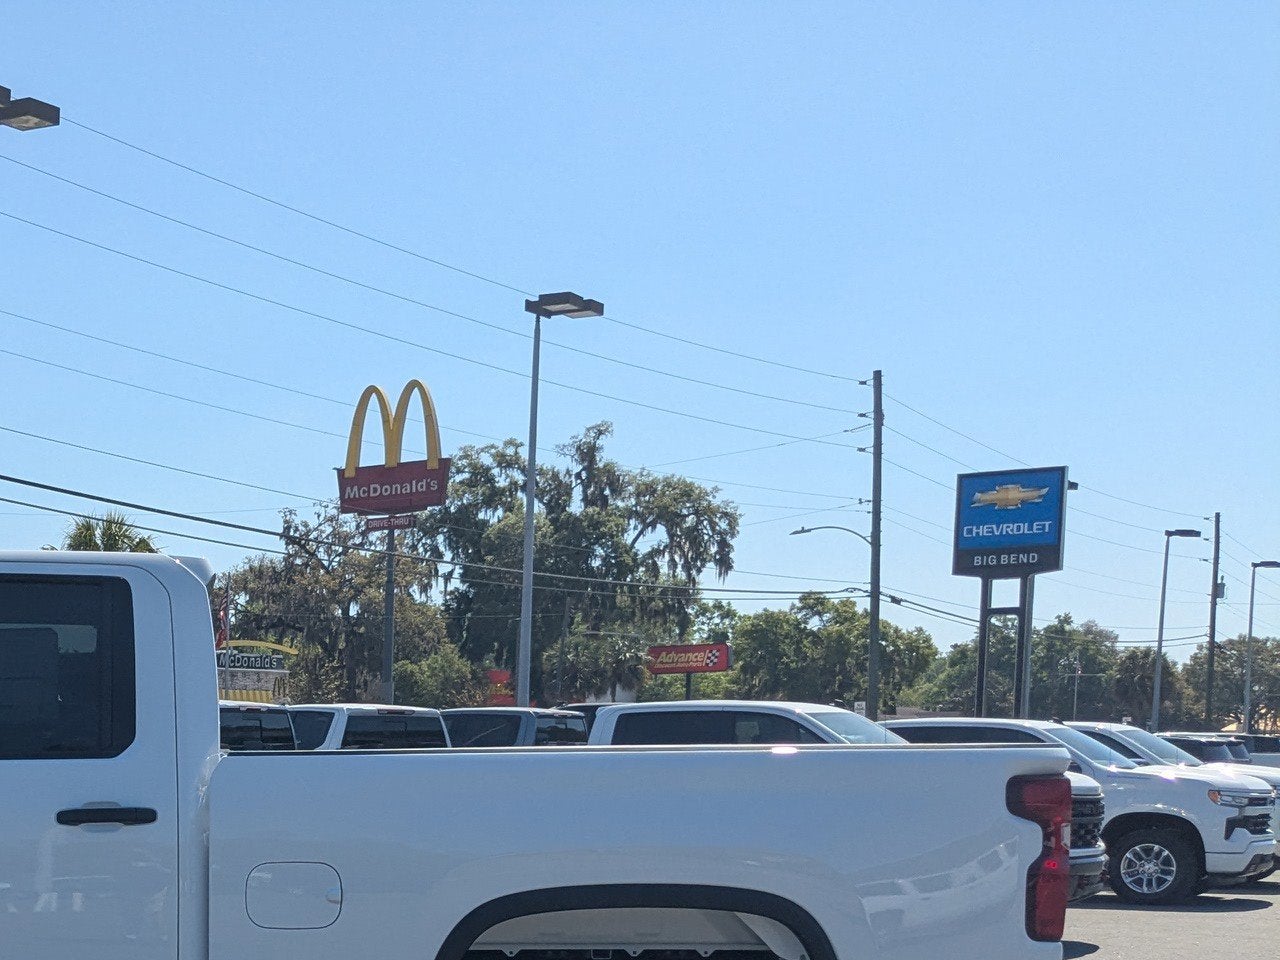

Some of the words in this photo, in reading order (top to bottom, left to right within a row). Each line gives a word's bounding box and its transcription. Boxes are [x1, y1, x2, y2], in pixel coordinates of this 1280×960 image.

[344, 478, 439, 500] McDonald's
[368, 517, 410, 529] DRIVE-THRU
[963, 520, 1052, 538] CHEVROLET
[973, 554, 997, 566] BIG
[1000, 552, 1039, 565] BEND
[657, 651, 704, 664] Advance
